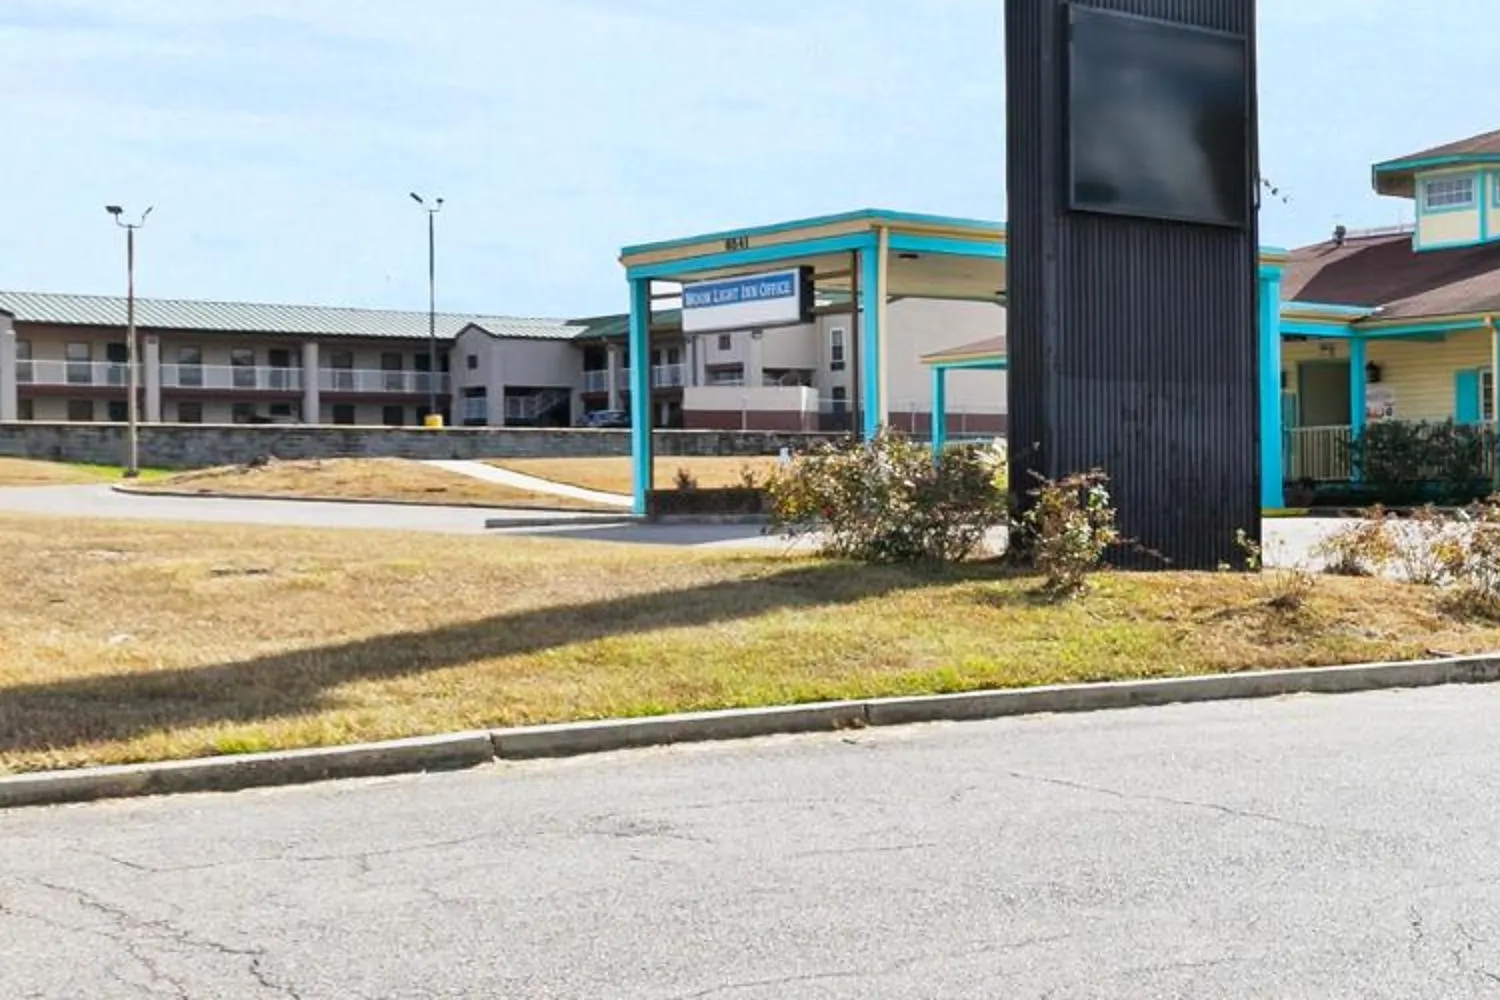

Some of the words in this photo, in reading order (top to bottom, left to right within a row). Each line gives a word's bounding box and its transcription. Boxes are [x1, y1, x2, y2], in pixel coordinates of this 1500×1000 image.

[713, 287, 739, 303] LIGHT
[741, 284, 757, 299] INN
[760, 280, 792, 297] OFFICE
